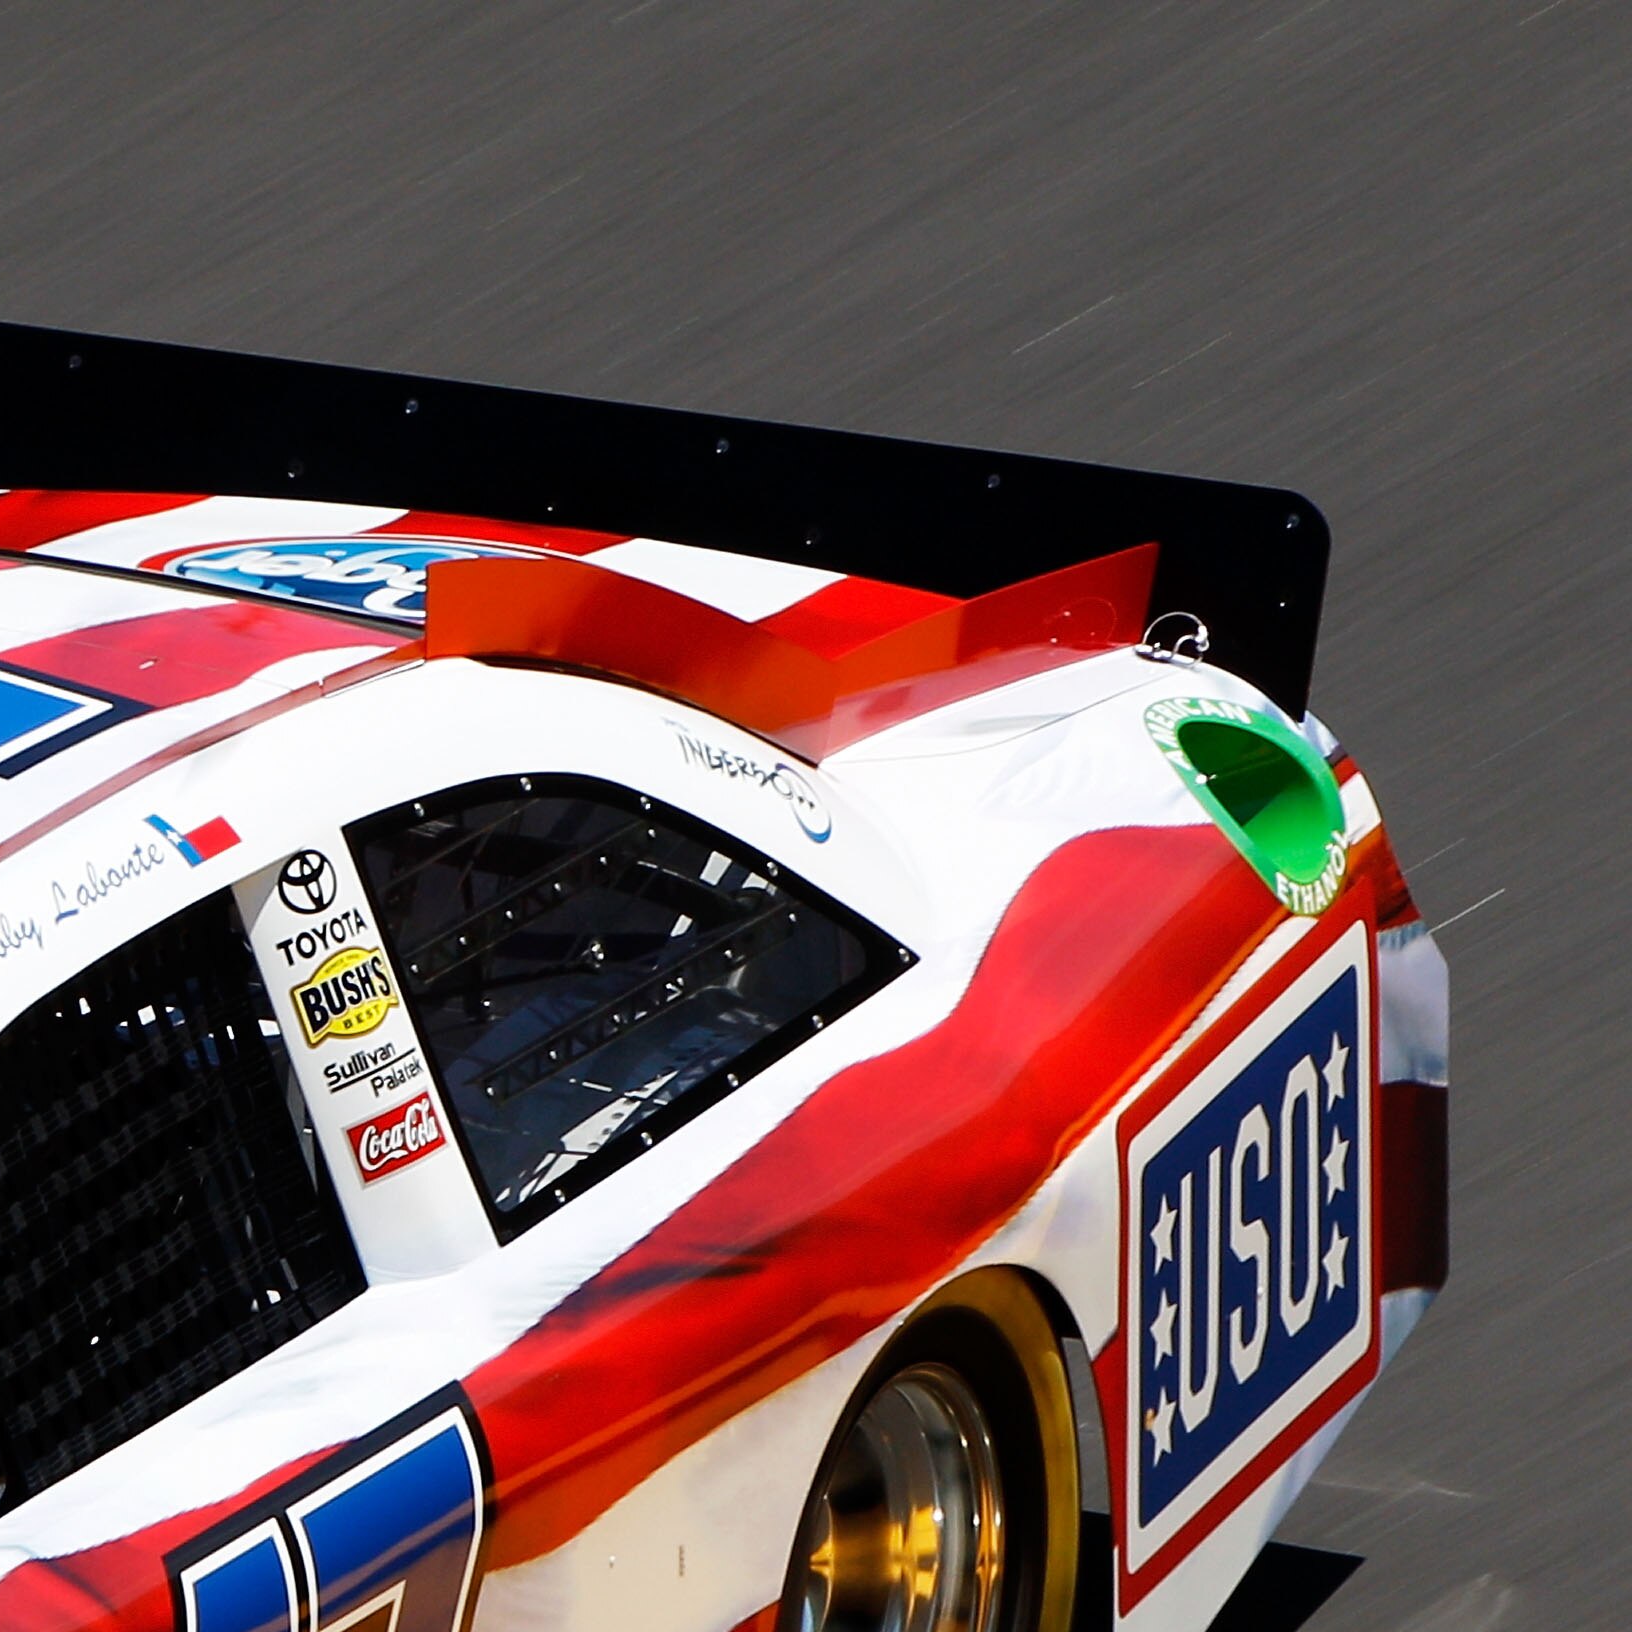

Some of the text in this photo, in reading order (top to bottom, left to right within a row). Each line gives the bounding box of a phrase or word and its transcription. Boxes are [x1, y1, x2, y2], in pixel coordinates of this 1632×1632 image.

[1144, 698, 1252, 772] AMERICAN
[53, 842, 166, 926] Labonte
[1275, 829, 1350, 915] ETHANOL
[276, 907, 368, 967] TOYOTA
[299, 955, 392, 1034] BUSH'S
[342, 1003, 381, 1030] BEST
[323, 1041, 397, 1087] Sullivan
[369, 1055, 425, 1098] Palatek
[1177, 1053, 1320, 1434] USO
